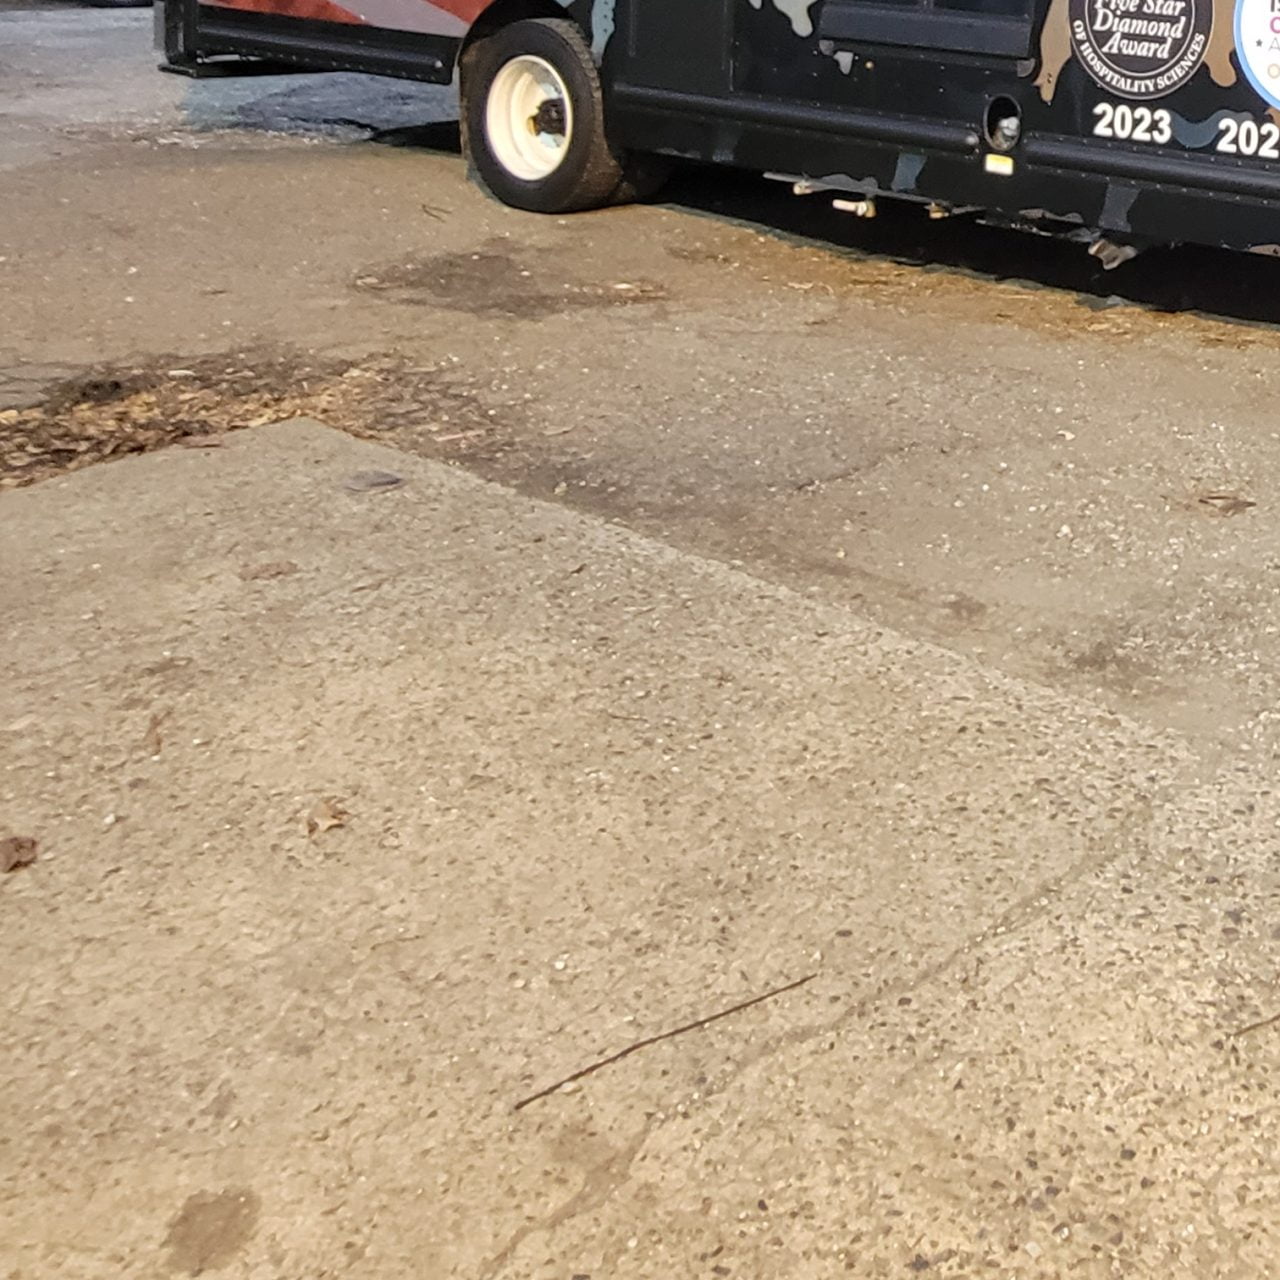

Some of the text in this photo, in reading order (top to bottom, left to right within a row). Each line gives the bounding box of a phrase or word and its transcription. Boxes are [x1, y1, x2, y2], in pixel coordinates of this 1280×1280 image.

[1093, 8, 1187, 39] Diamond
[1073, 20, 1206, 93] OF HOSPITALITY SCIENCES
[1102, 32, 1173, 59] Award
[1092, 102, 1172, 144] 2023
